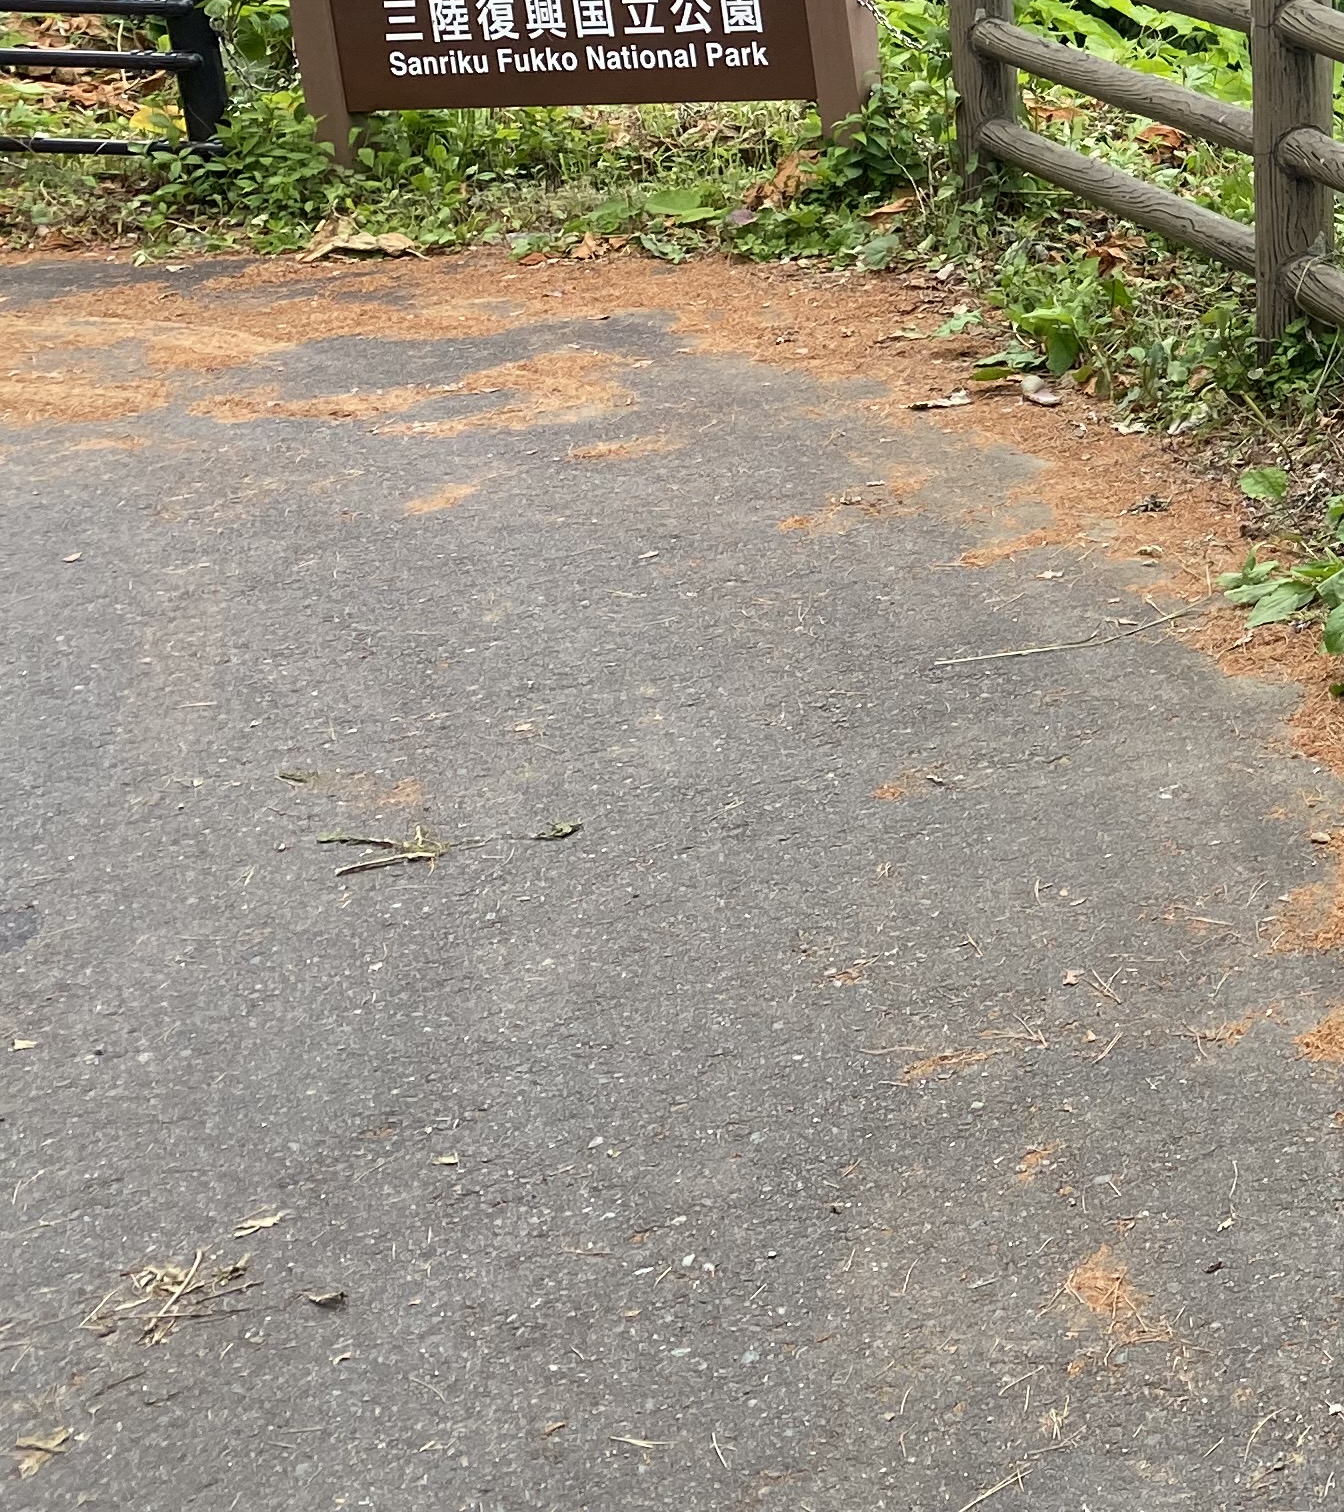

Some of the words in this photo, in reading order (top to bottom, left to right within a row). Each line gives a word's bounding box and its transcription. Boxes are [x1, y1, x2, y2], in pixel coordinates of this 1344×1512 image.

[389, 49, 489, 76] Sanriku
[496, 46, 578, 73] Fukko
[585, 42, 697, 71] National
[705, 41, 769, 68] Park
